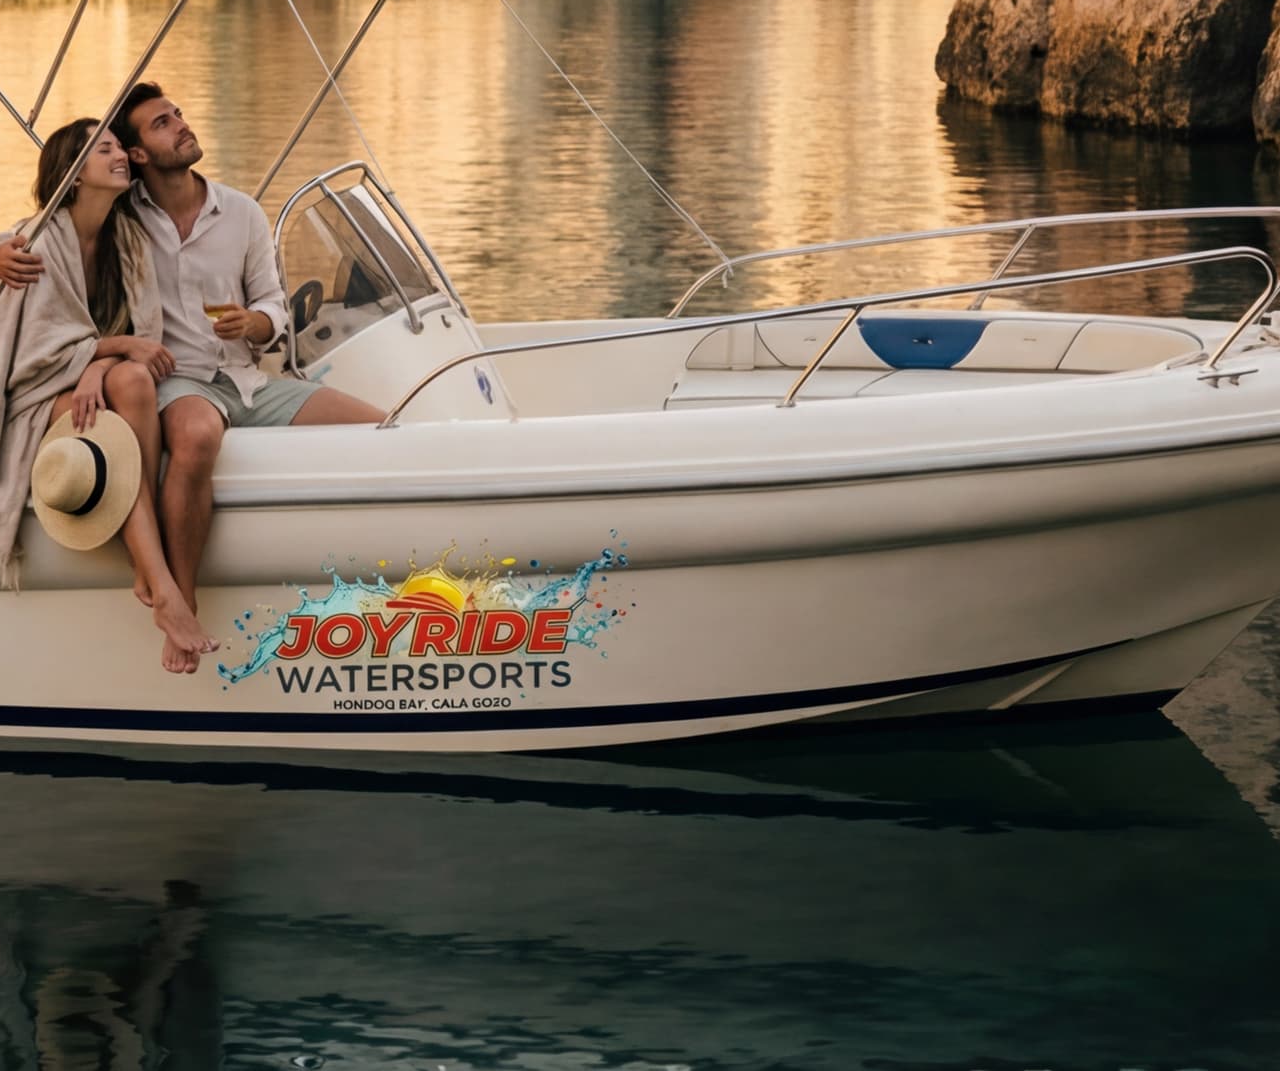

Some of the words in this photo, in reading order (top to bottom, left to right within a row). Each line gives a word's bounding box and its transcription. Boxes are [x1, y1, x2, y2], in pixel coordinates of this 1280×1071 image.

[274, 609, 572, 660] JOYRIDE
[276, 661, 572, 693] WATERSPORTS
[431, 698, 468, 709] CALA
